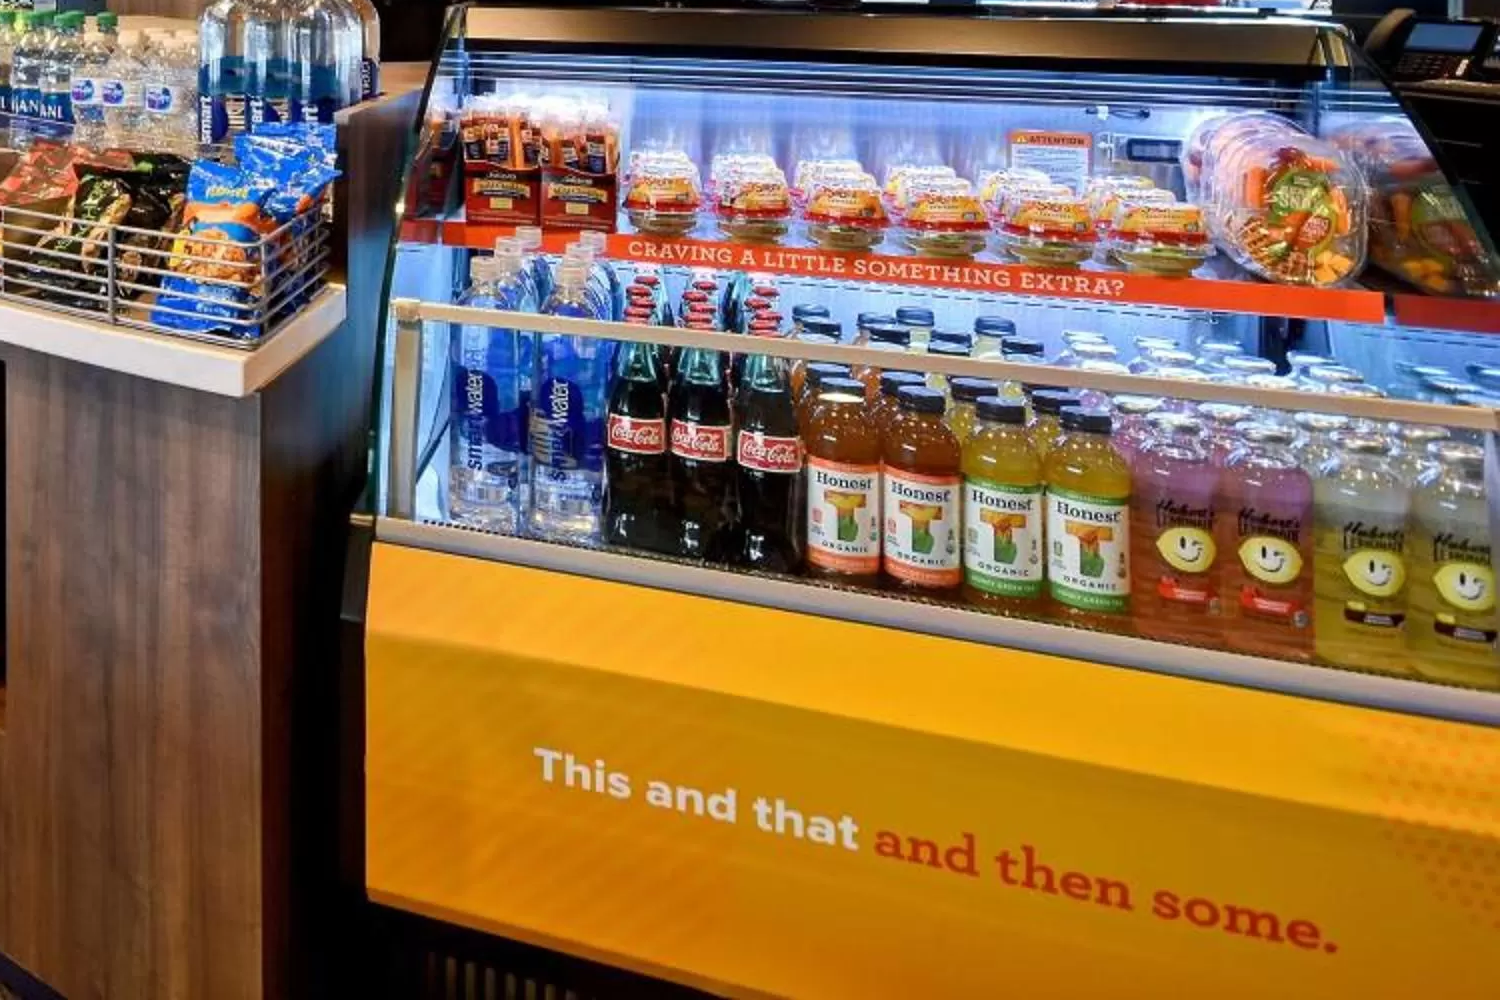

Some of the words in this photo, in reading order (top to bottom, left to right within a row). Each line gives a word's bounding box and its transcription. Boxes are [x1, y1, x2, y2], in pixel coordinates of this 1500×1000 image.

[628, 241, 732, 264] CRAVING
[740, 249, 756, 265] A
[763, 252, 845, 273] LITTLE
[854, 259, 1011, 287] SOMETHING
[1020, 271, 1125, 297] EXTRA?
[816, 471, 873, 490] Honest
[891, 481, 952, 503] Honest
[972, 489, 1033, 512] Honest
[1056, 501, 1121, 523] Honest
[822, 540, 869, 553] ORGANIC
[898, 551, 948, 567] ORGANIC
[978, 561, 1030, 577] ORGANIC
[1063, 575, 1117, 591] ORGANIC
[533, 747, 632, 799] This
[646, 780, 737, 824] and
[752, 797, 860, 851] that
[874, 832, 981, 877] and
[995, 845, 1133, 911] then
[1152, 889, 1338, 954] some.
